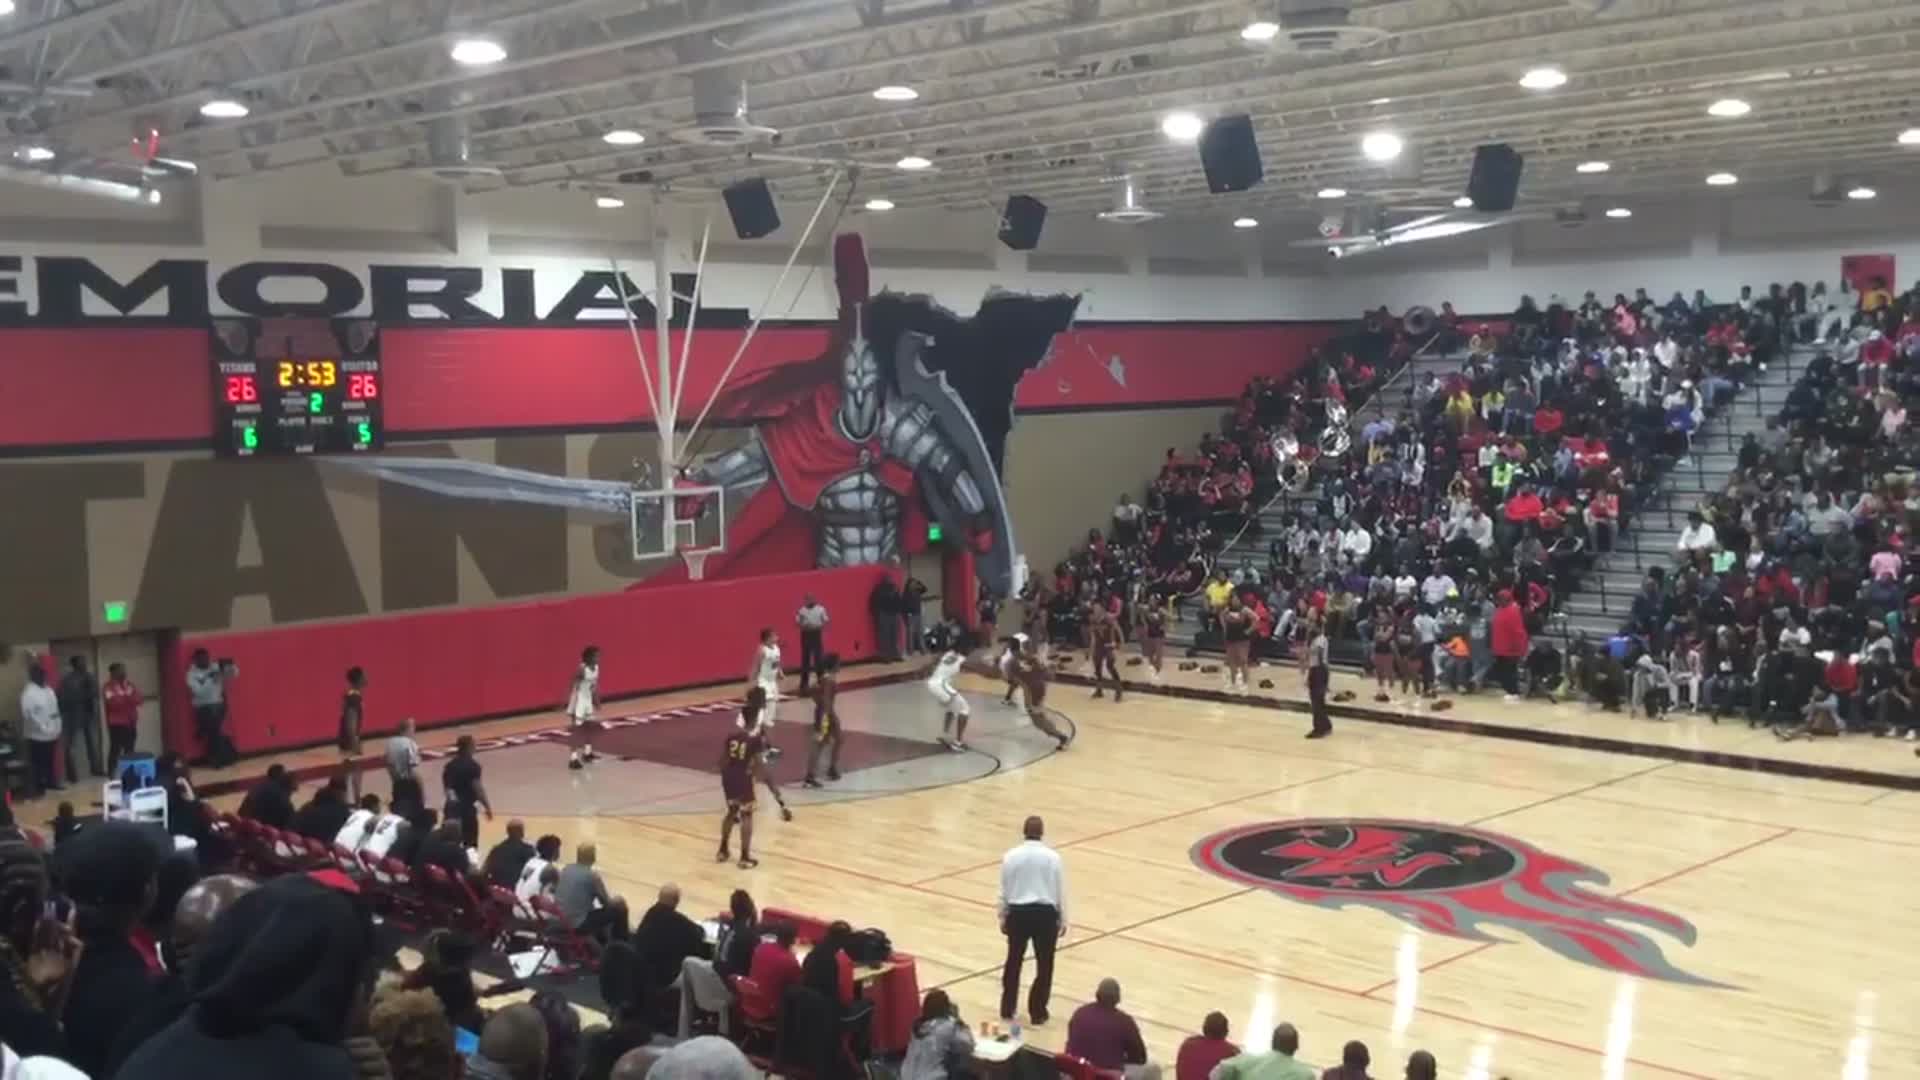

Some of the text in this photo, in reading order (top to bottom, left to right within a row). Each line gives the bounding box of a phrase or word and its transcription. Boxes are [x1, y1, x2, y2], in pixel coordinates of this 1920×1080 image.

[0, 256, 749, 323] MORIAL
[278, 361, 336, 387] 2:53
[226, 377, 257, 401] 26
[349, 375, 377, 398] 26
[309, 392, 323, 413] 2
[243, 426, 257, 448] 6
[358, 423, 372, 443] 5
